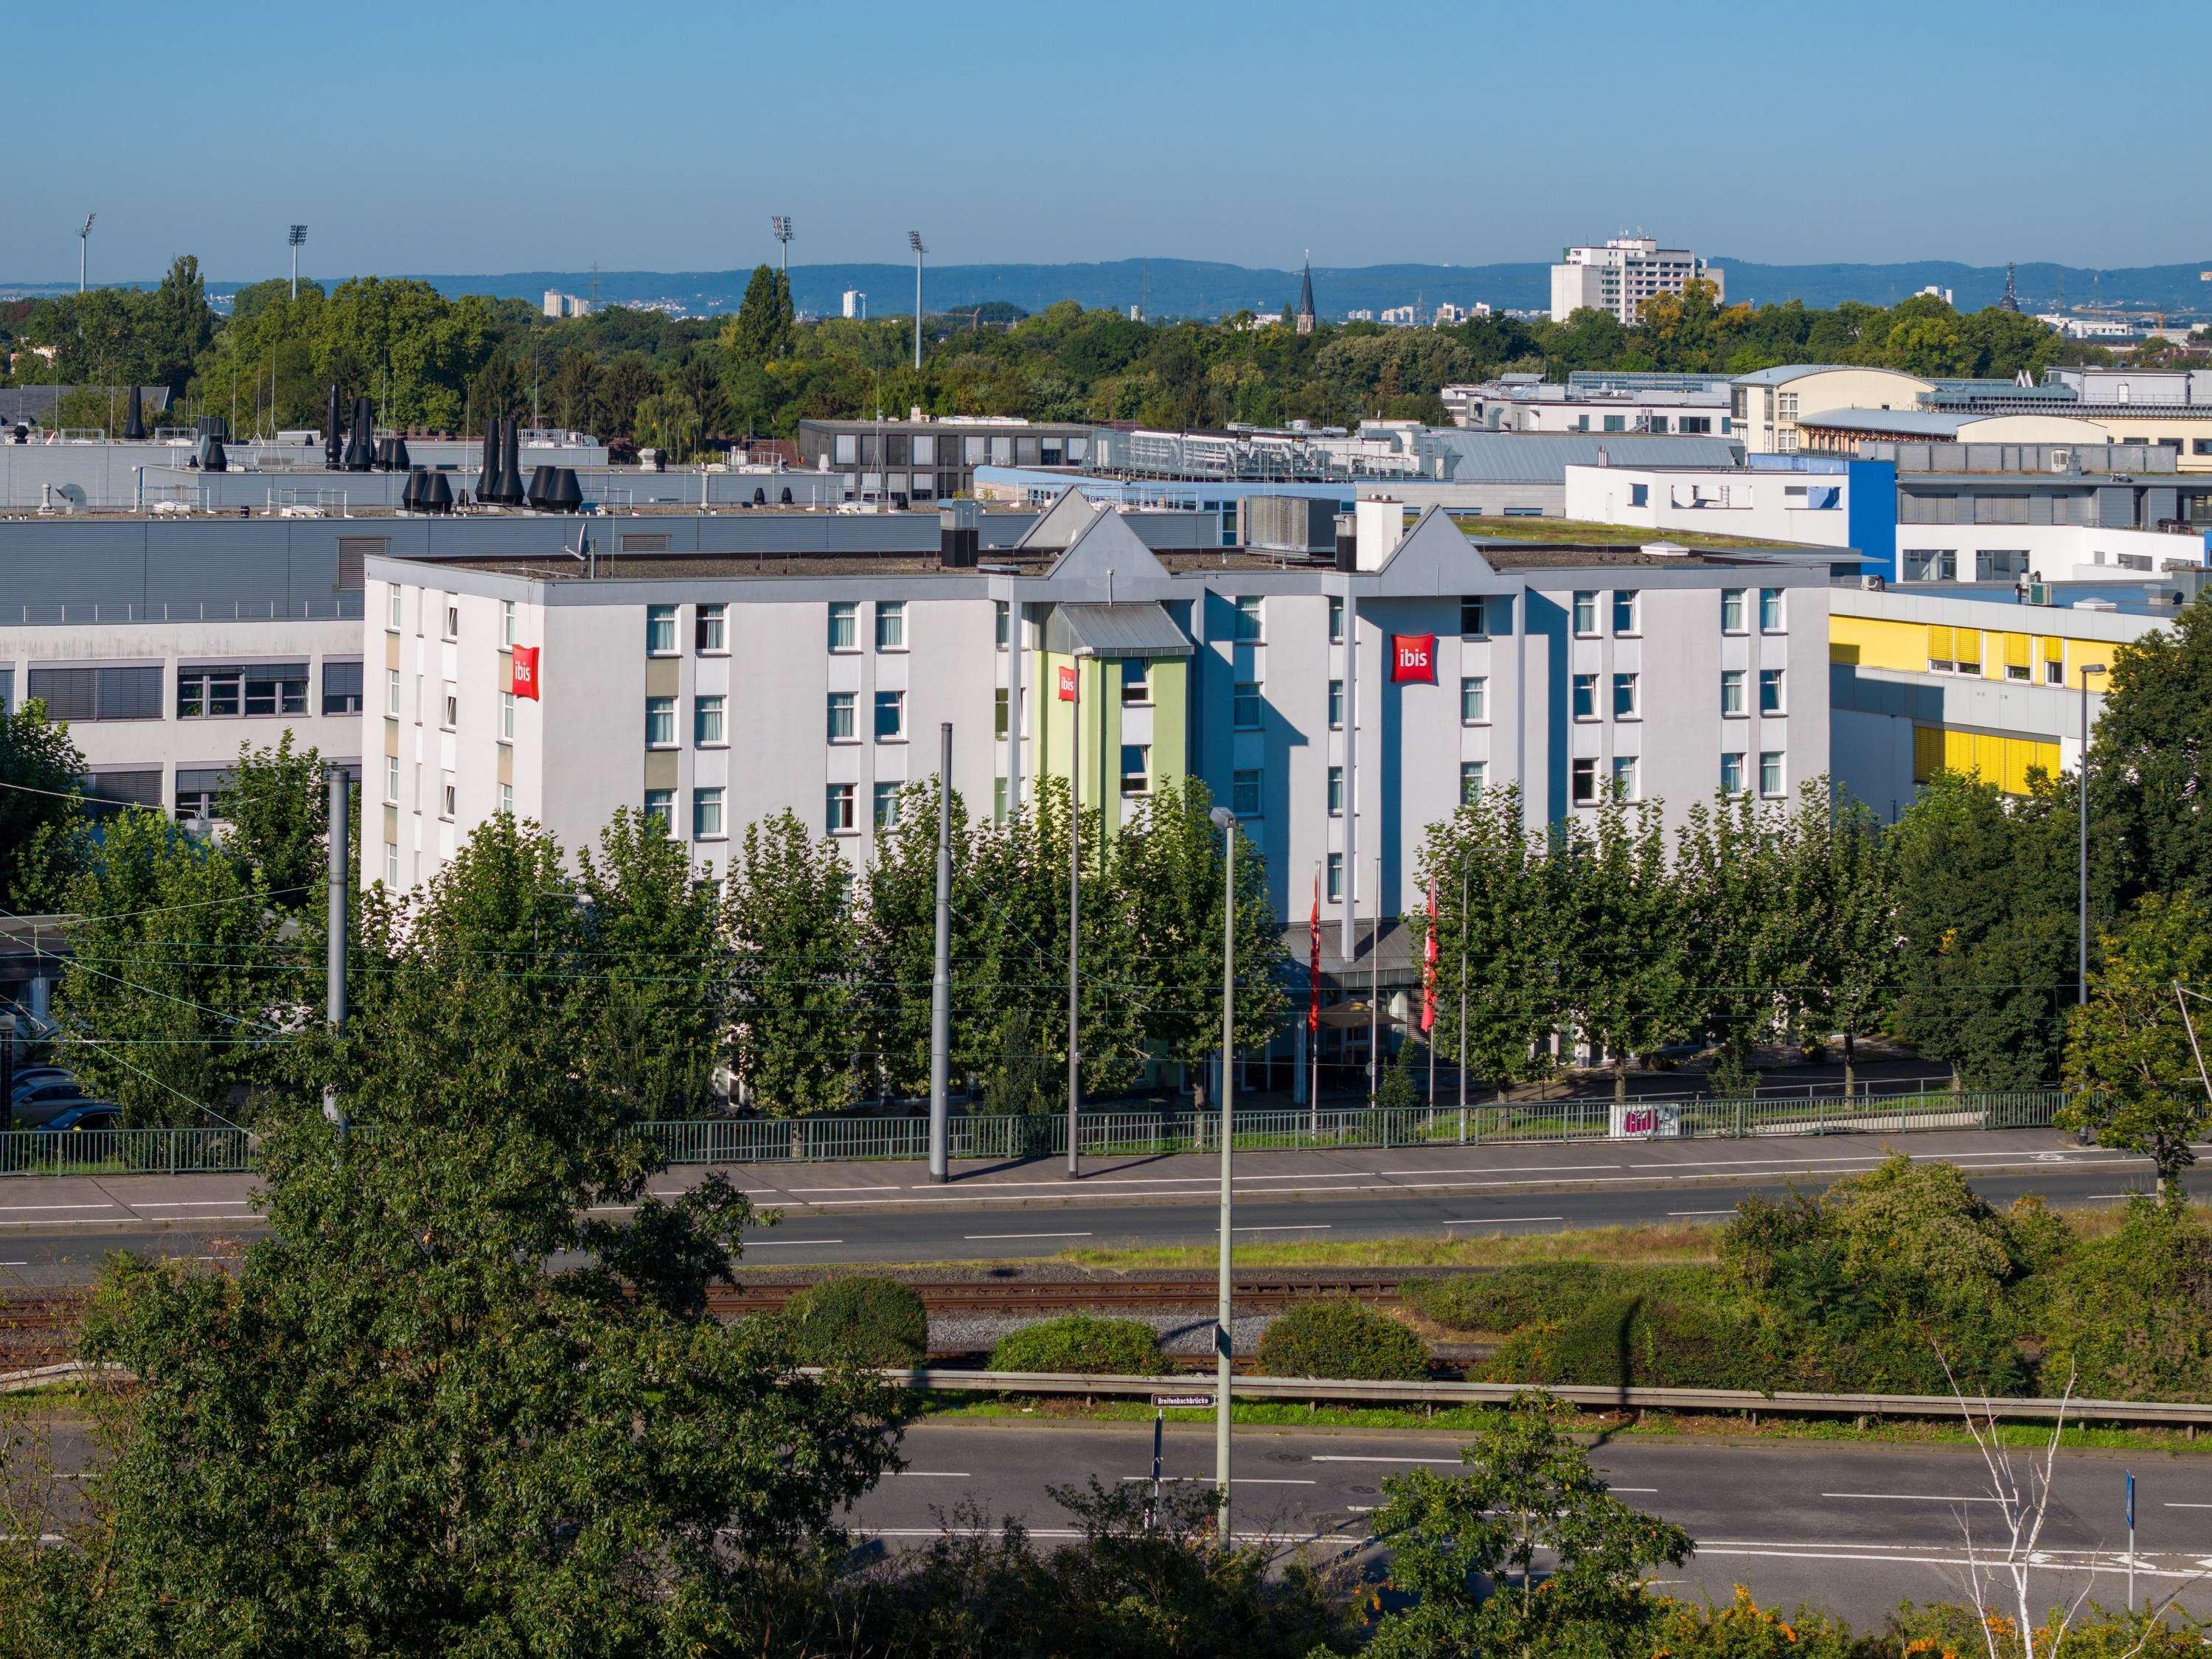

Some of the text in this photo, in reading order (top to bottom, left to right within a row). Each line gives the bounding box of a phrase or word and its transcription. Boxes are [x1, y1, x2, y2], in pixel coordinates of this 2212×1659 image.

[1399, 648, 1428, 667] ibis
[515, 660, 531, 683] ibis
[1061, 676, 1074, 692] ibis
